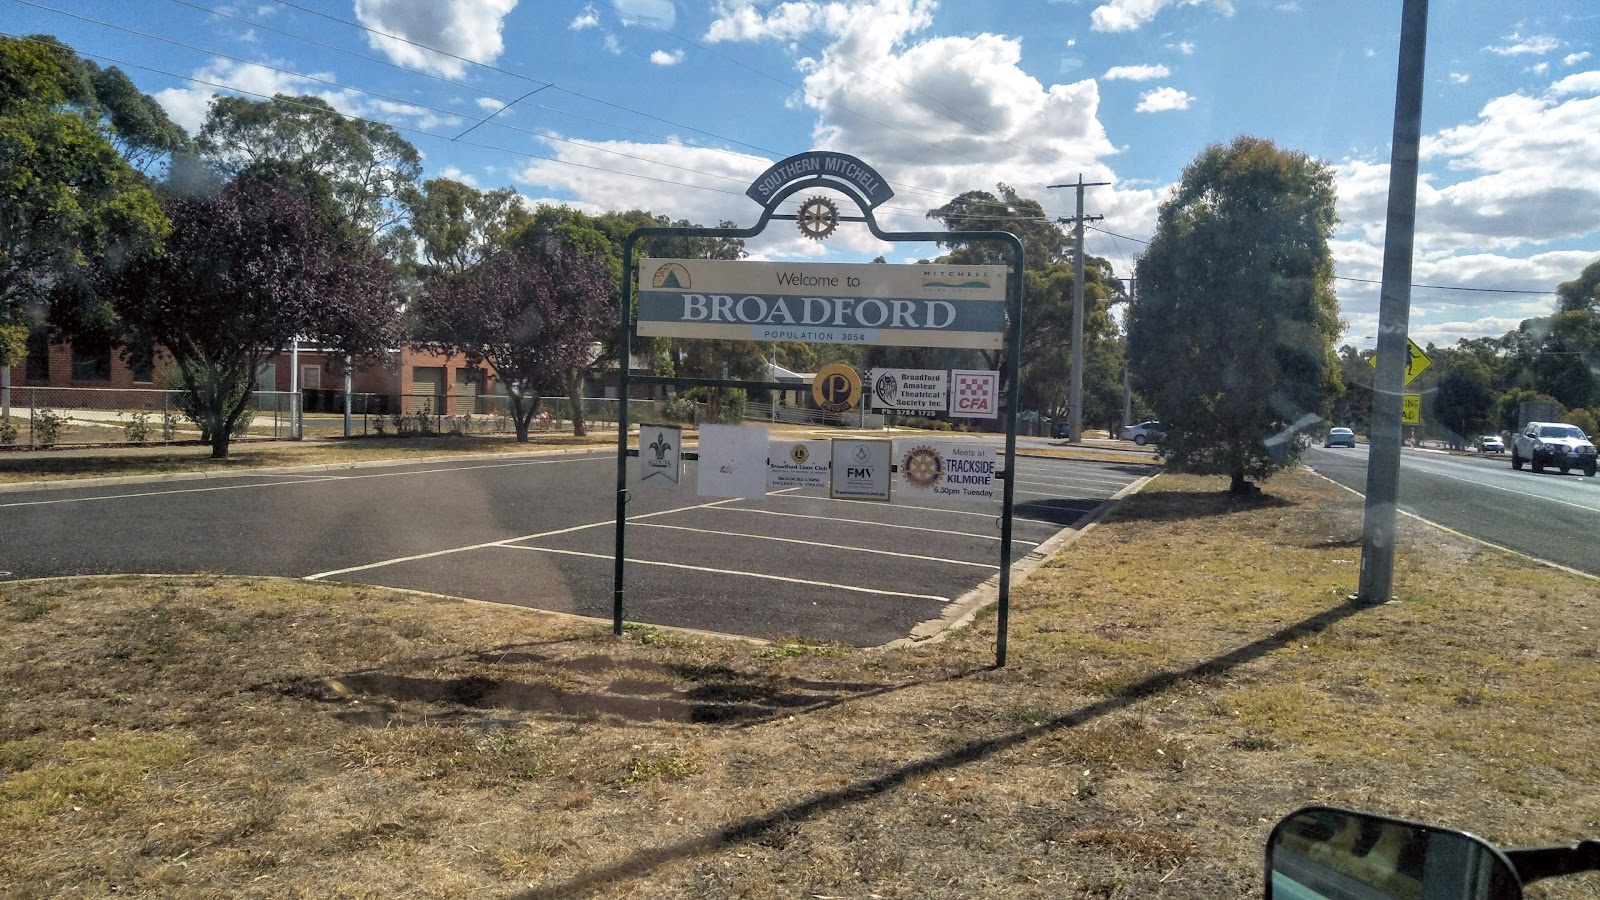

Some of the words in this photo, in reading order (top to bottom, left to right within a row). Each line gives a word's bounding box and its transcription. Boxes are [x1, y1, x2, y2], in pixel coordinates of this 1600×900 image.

[758, 158, 820, 196] SOUTHERN
[824, 157, 880, 195] MITCHELL
[776, 271, 839, 287] Welcome
[847, 275, 861, 288] to
[681, 293, 957, 329] BROADFORD
[764, 330, 833, 341] POPULATION
[841, 333, 865, 342] 3054
[901, 373, 940, 382] Broadford
[903, 382, 936, 390] Amateur
[900, 390, 940, 398] Theatrical
[822, 401, 850, 412] PROBUS
[896, 399, 926, 407] Society
[929, 400, 944, 408] Inc.
[958, 397, 988, 410] CFA
[1403, 399, 1418, 408] ING
[952, 448, 976, 457] Meets
[946, 459, 995, 474] TRACKSIDE
[847, 467, 875, 479] FMV
[947, 474, 991, 485] KILMORE
[933, 486, 960, 496] 6.30pm
[962, 488, 993, 498] Tuesday
